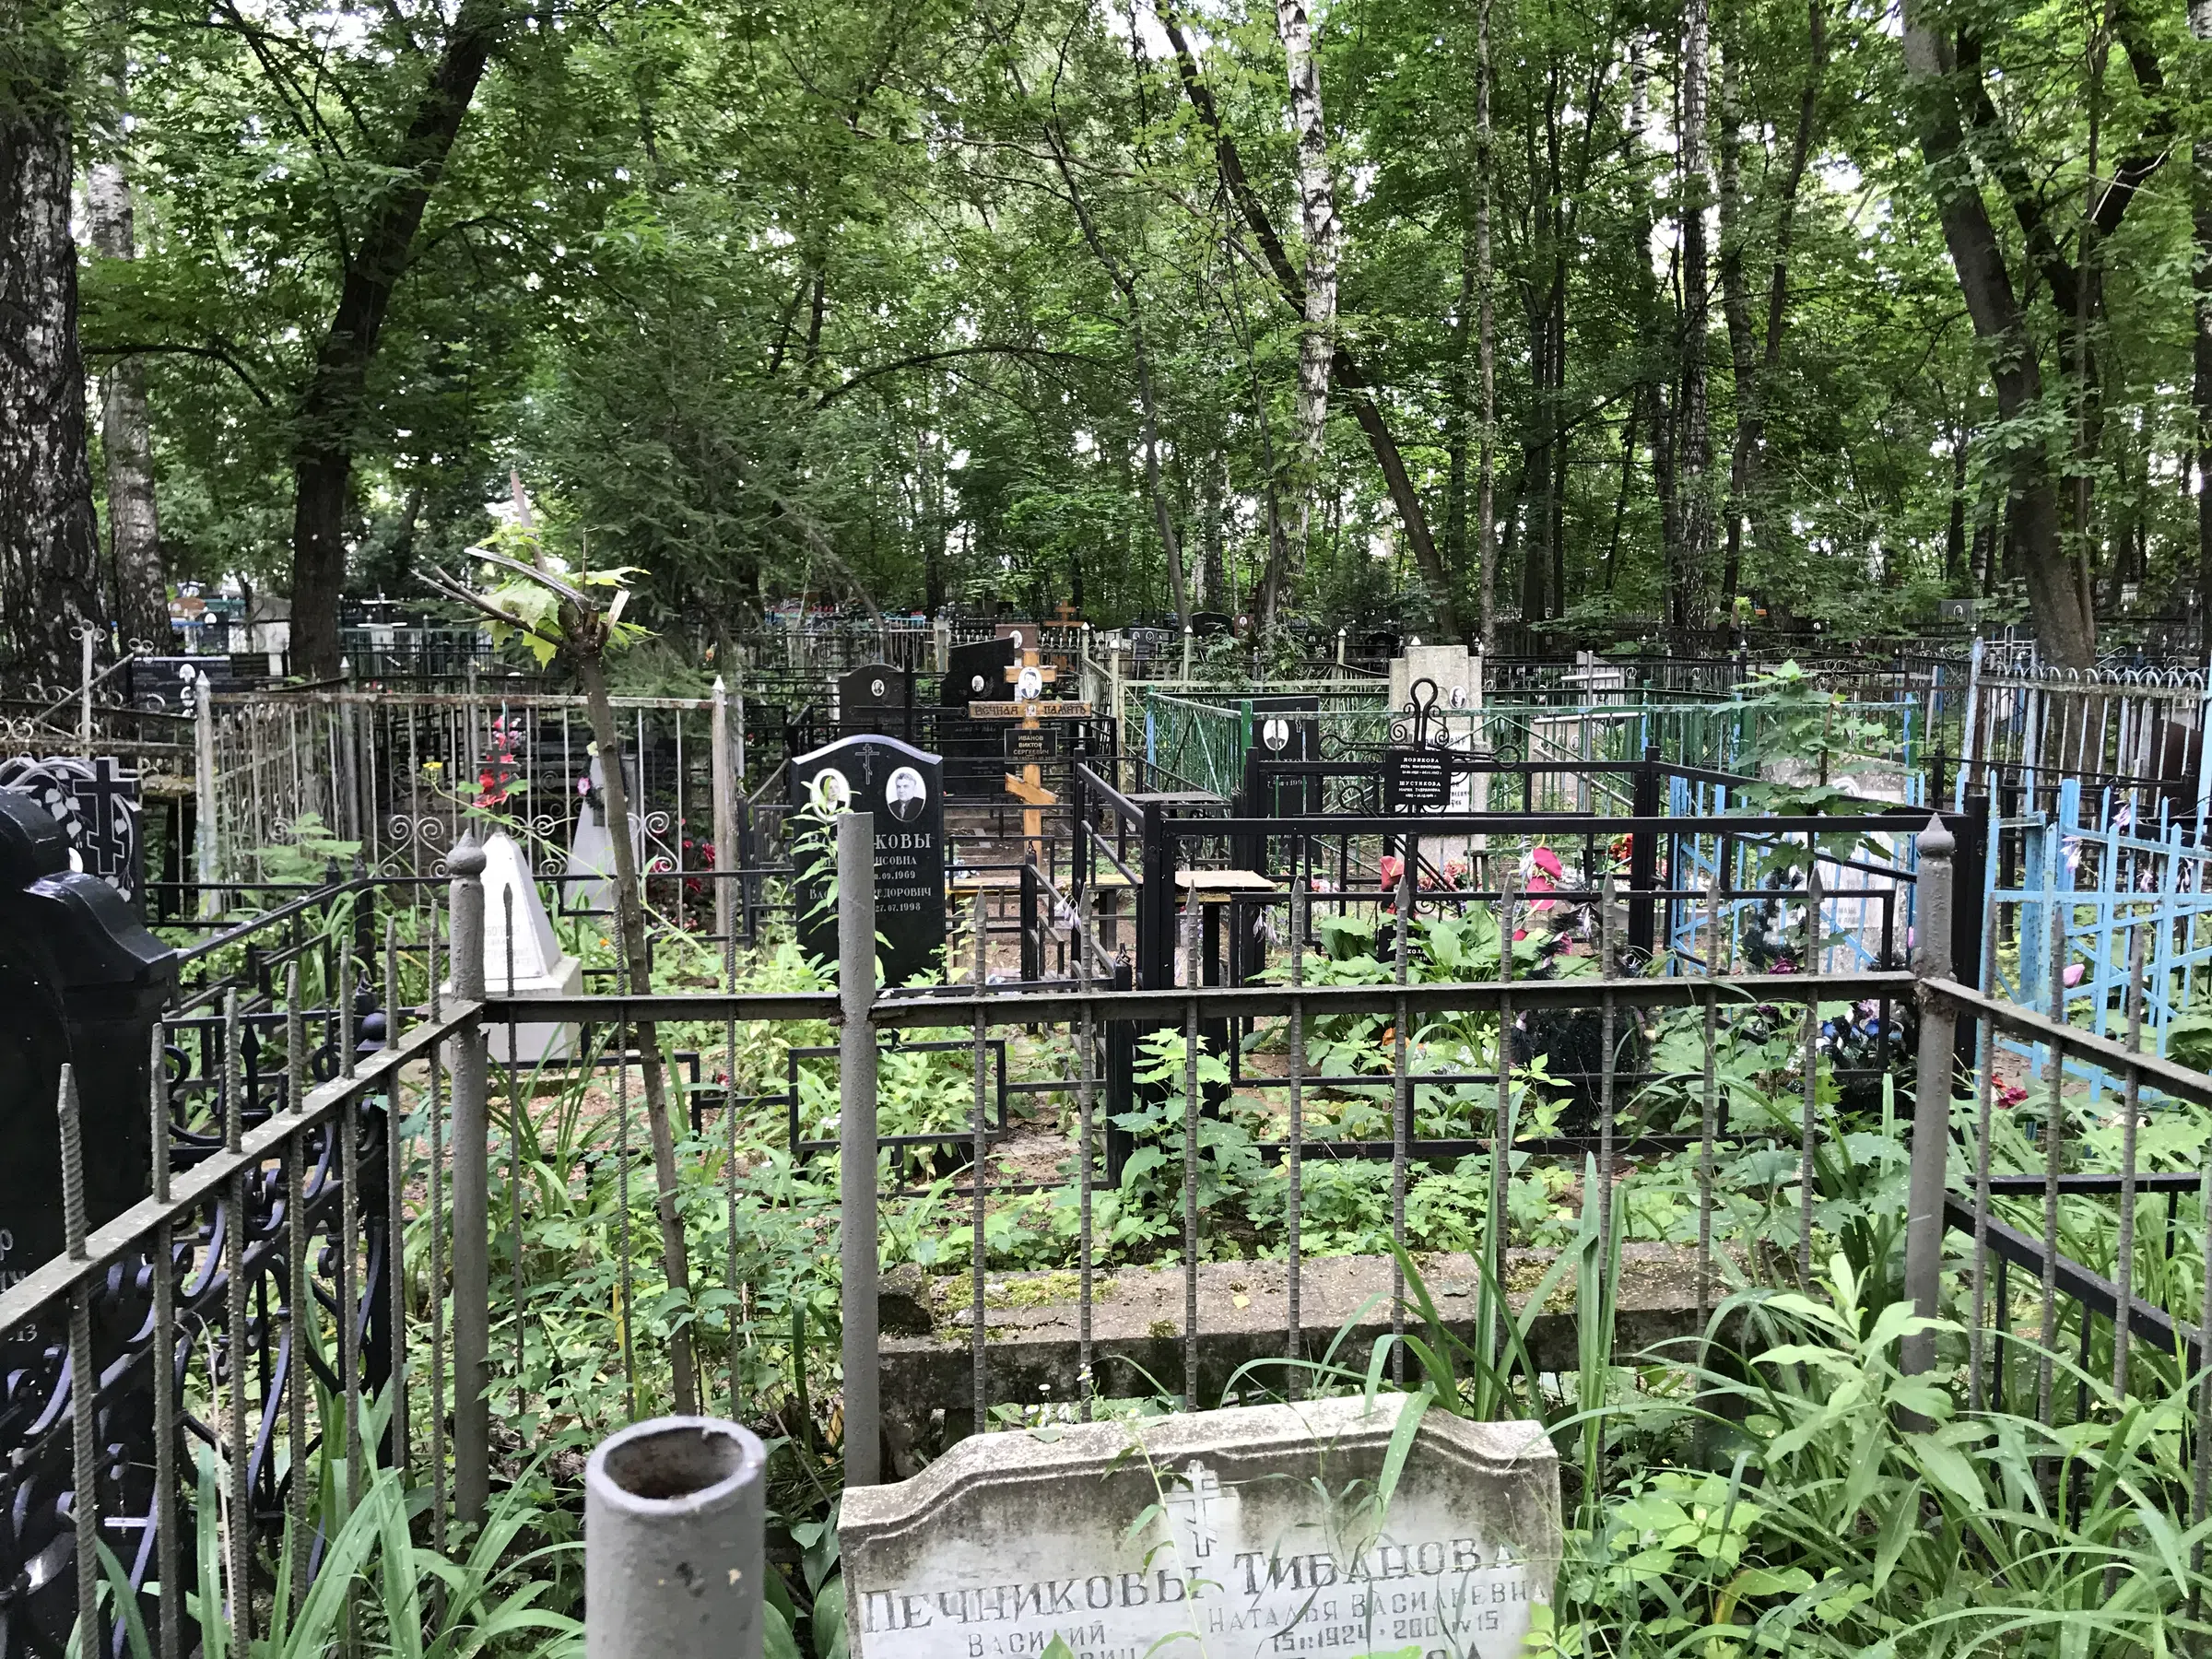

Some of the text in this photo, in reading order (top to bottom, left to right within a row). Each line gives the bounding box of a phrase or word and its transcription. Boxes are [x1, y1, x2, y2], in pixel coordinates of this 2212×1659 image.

[1043, 705, 1087, 715] ПАМЯТЬ
[808, 833, 932, 851] ВОКОВЫ
[860, 1536, 1526, 1634] ПЕЧНИКОВЫ ТИБАНОВА
[1207, 1599, 1339, 1634] НАТАЛЬЯ
[1393, 1615, 1450, 1640] 200
[968, 1619, 1106, 1659] ВАСИИЙ
